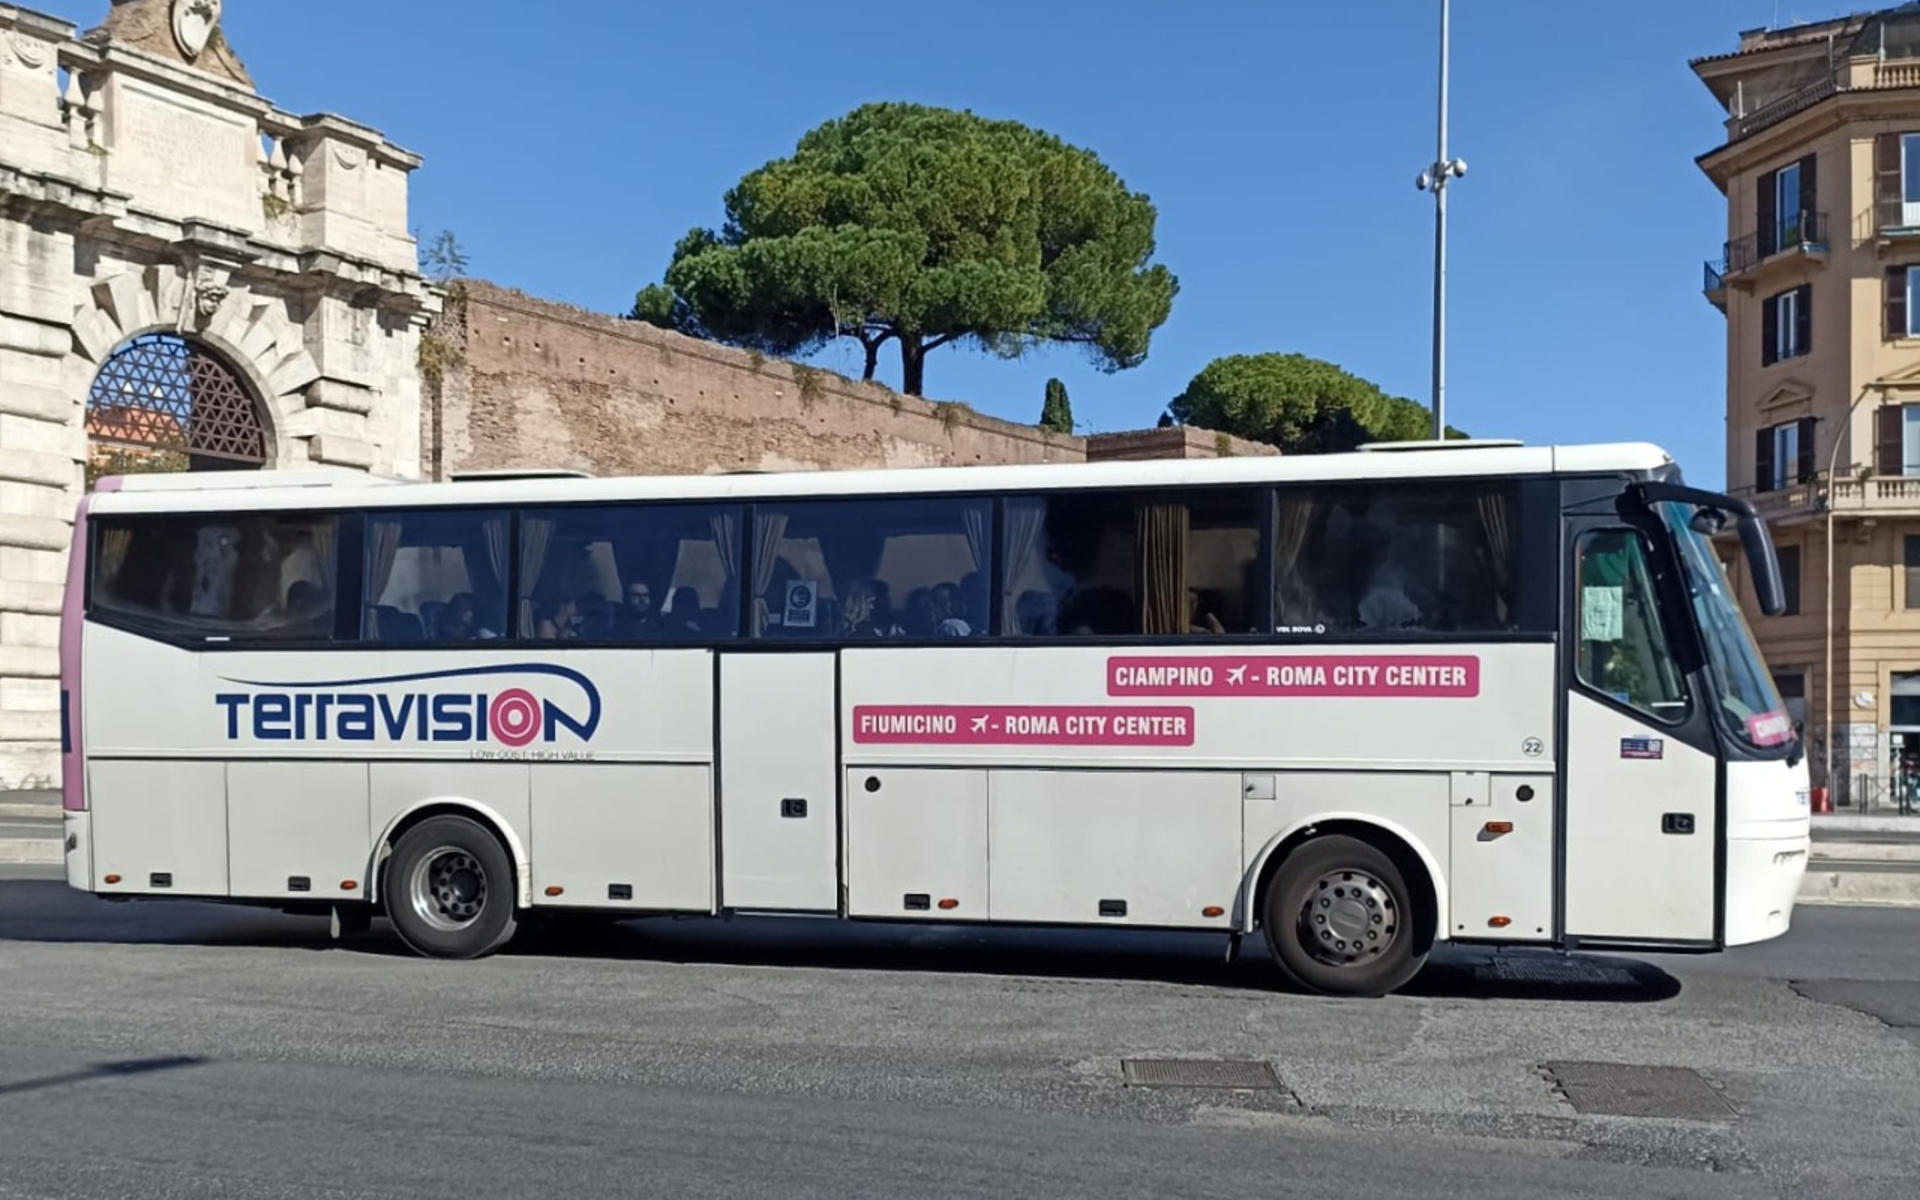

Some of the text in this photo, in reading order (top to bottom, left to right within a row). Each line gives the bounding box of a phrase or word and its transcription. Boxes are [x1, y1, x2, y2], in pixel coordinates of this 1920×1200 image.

[1115, 666, 1214, 686] CIAMPINO
[1266, 666, 1327, 687] ROMA
[1333, 666, 1380, 687] CITY
[1385, 666, 1467, 687] CENTER
[861, 715, 957, 734] FIUMICINO
[1005, 715, 1060, 735] ROMA
[1065, 716, 1108, 735] CITY
[1112, 716, 1187, 736] CENTER
[469, 750, 495, 760] LOW
[1525, 742, 1541, 753] 22
